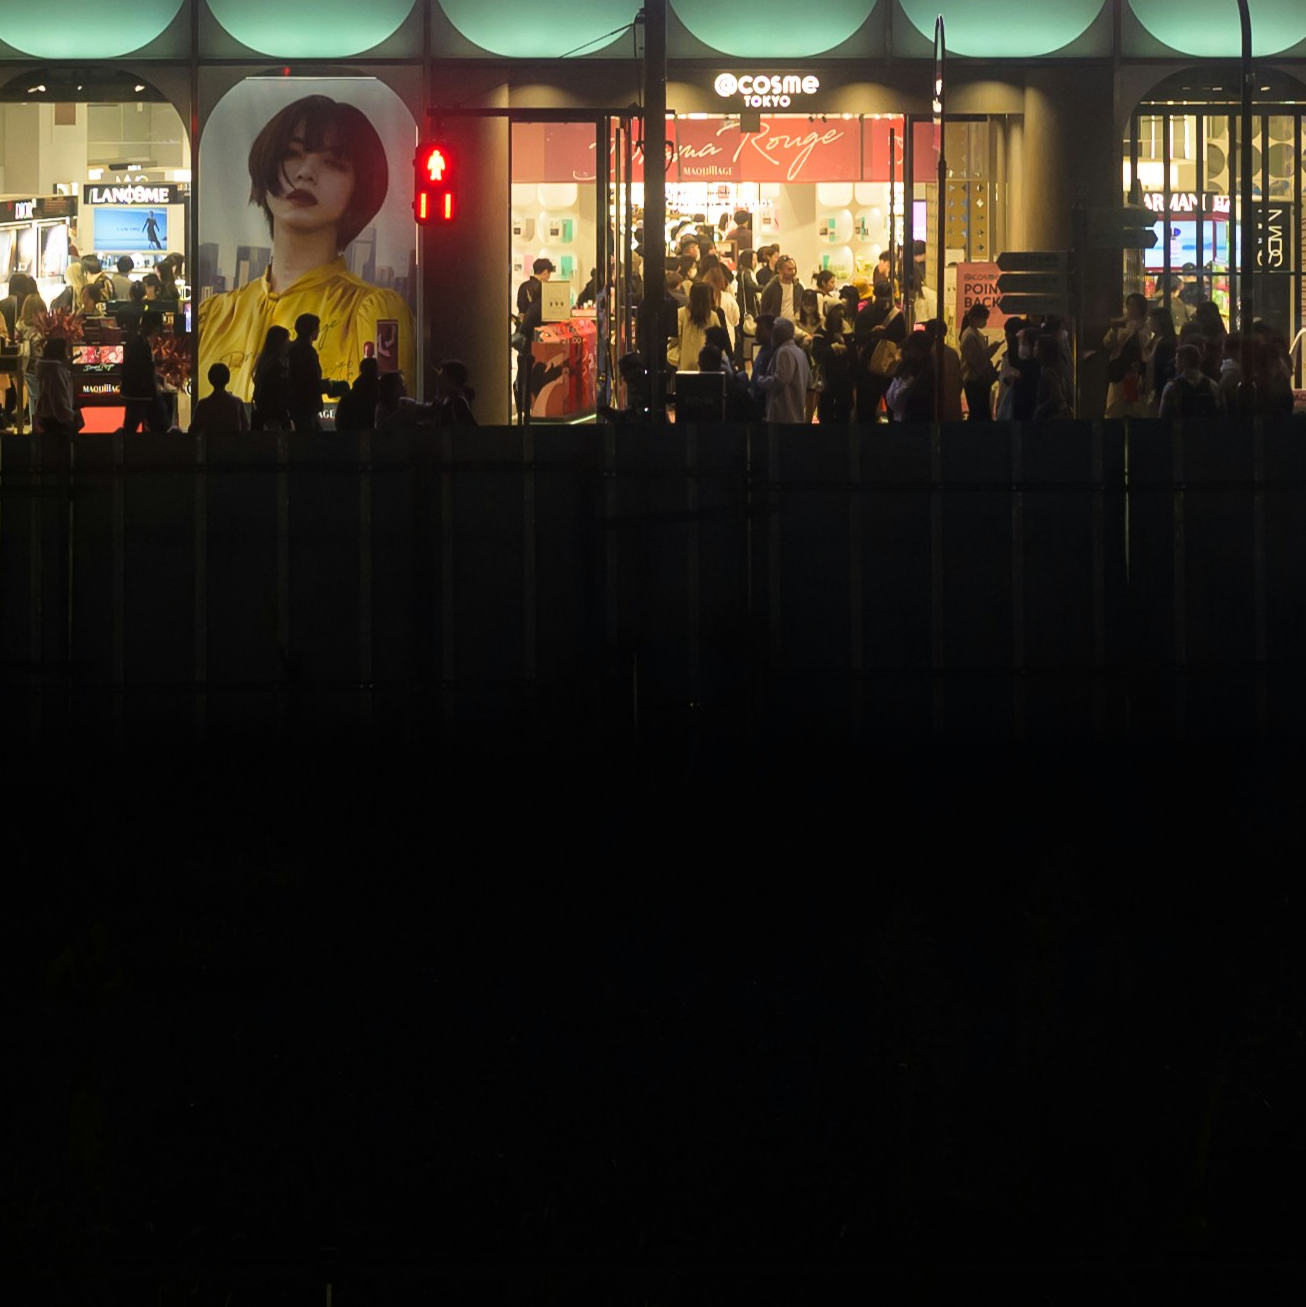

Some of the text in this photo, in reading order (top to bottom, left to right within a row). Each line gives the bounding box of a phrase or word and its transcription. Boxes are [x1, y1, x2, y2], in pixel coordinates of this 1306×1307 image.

[714, 73, 820, 97] @cosme
[744, 95, 791, 108] TOKYO
[716, 121, 844, 181] Rouge
[964, 283, 999, 295] POIN
[964, 297, 1001, 308] BACK
